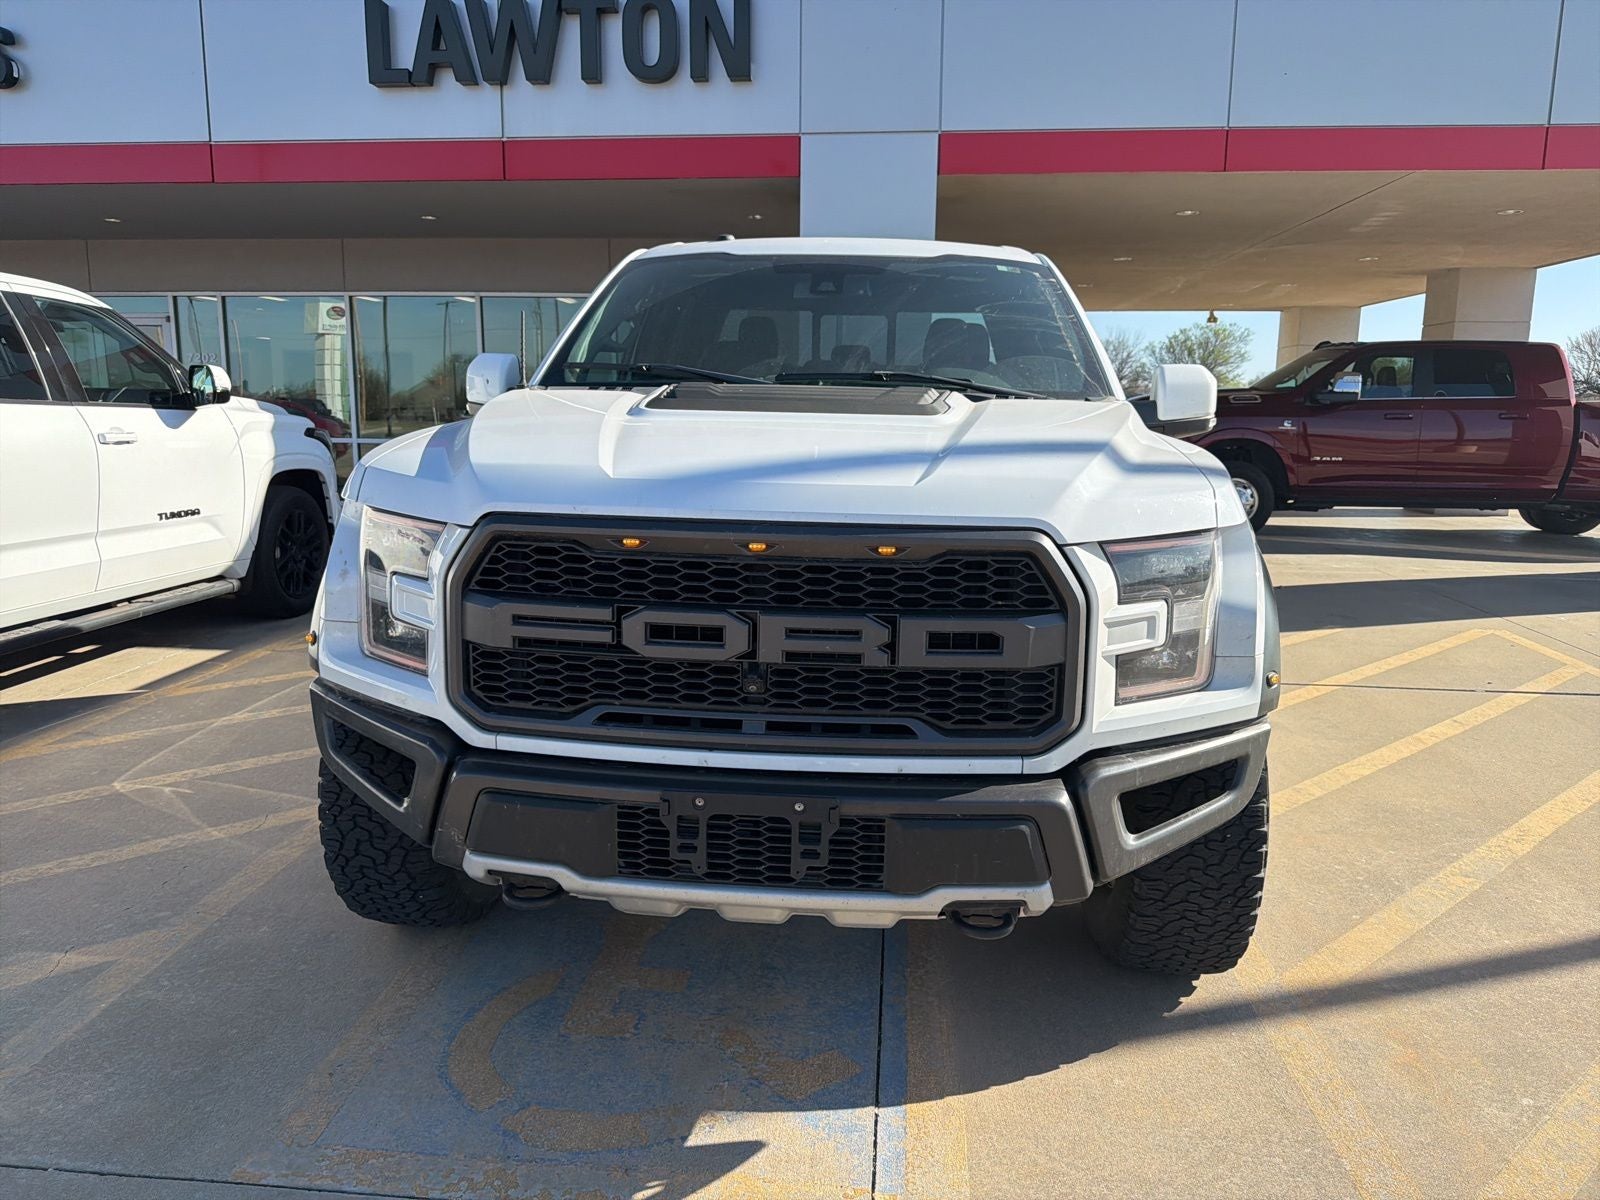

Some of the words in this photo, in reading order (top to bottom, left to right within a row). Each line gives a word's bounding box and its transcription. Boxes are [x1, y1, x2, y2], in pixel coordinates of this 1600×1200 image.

[364, 0, 752, 87] LAWTON
[157, 508, 201, 521] TUNDRA
[463, 600, 1063, 669] FORD
